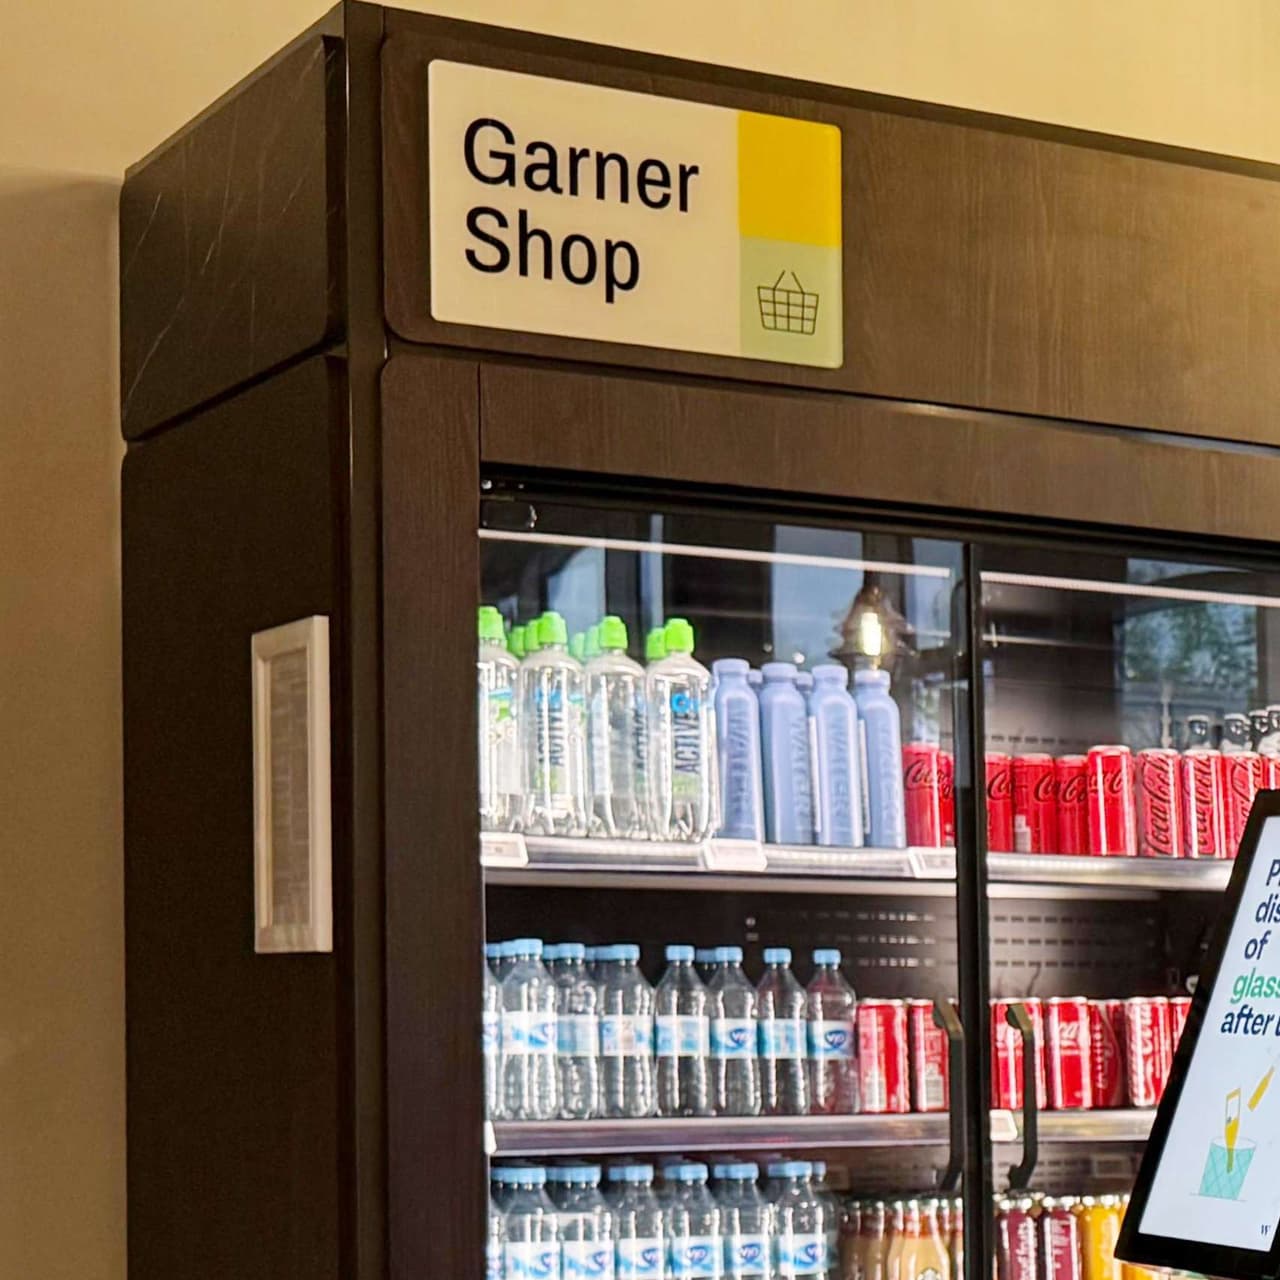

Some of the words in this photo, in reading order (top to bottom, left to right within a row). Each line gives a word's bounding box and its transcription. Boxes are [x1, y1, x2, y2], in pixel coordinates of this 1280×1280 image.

[463, 117, 700, 212] Garner
[464, 206, 640, 304] Shop
[1243, 931, 1272, 960] of
[1220, 1004, 1276, 1037] after
